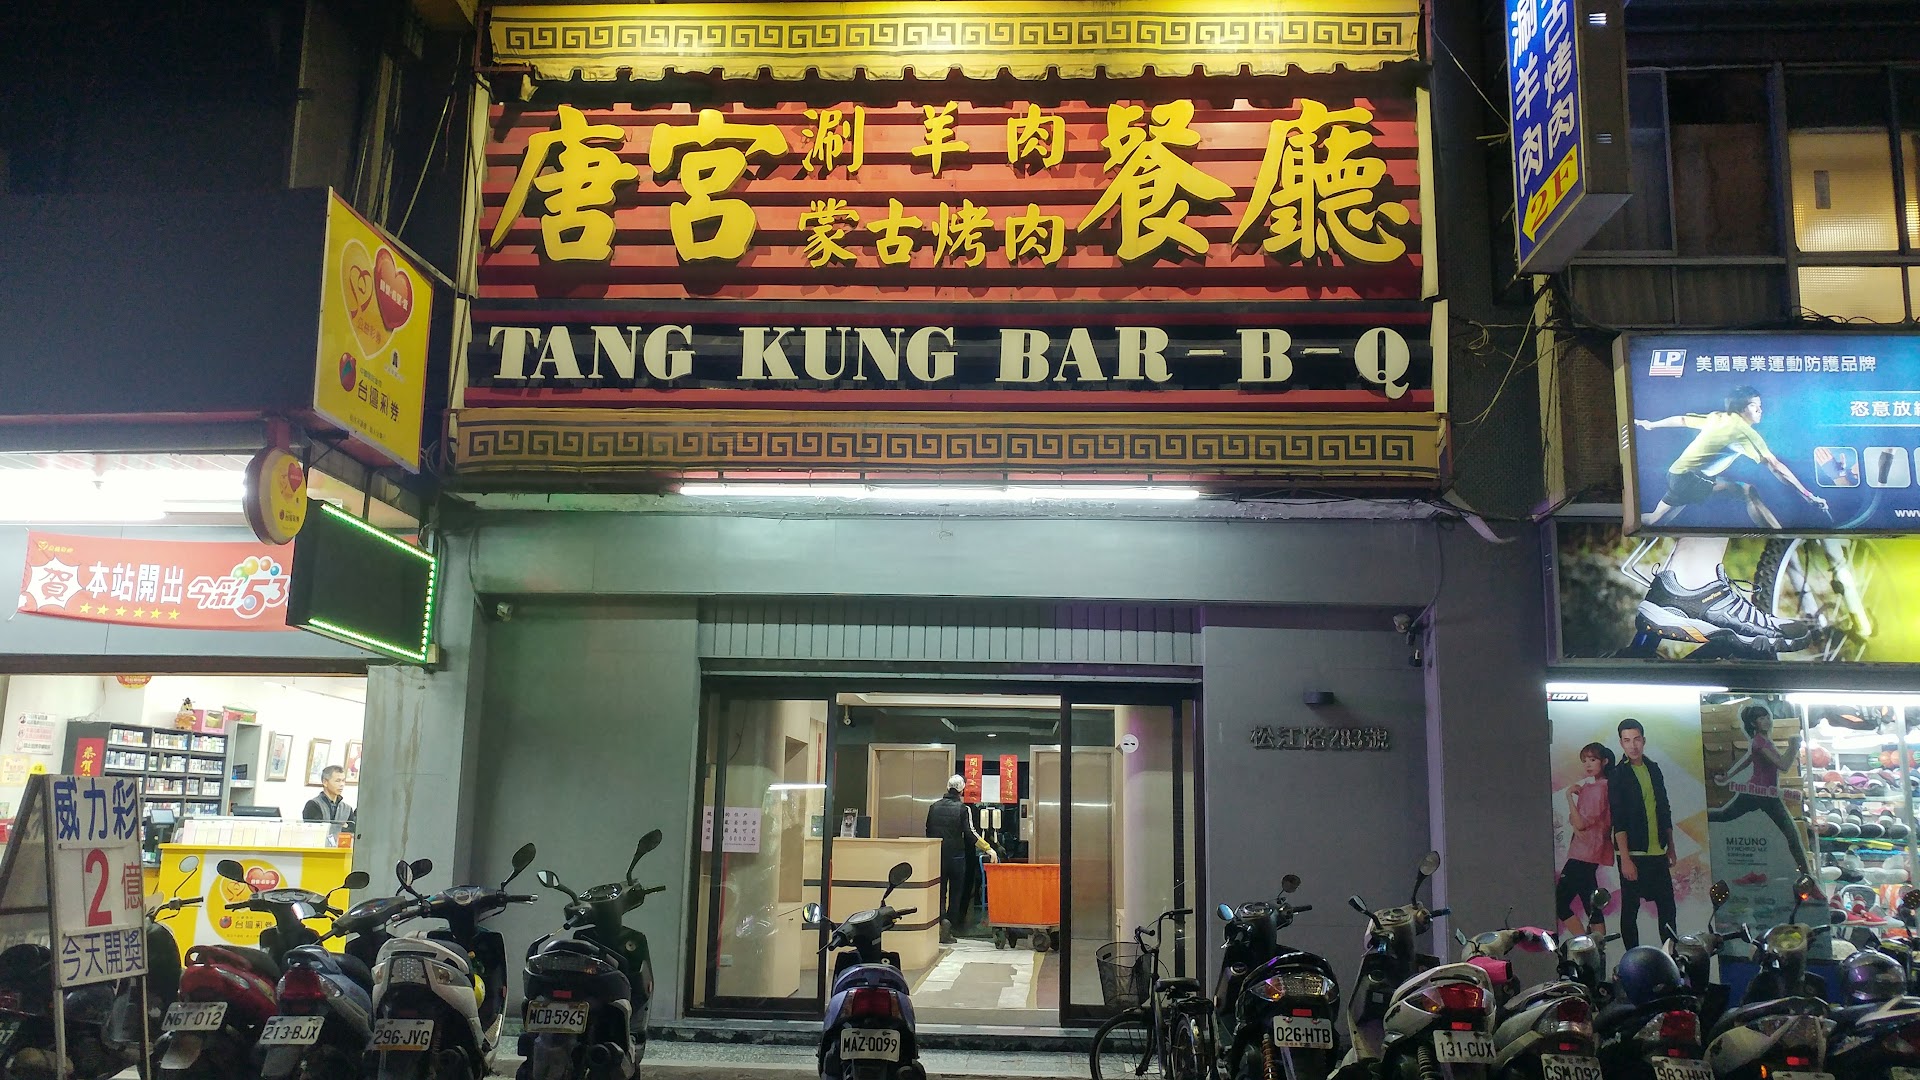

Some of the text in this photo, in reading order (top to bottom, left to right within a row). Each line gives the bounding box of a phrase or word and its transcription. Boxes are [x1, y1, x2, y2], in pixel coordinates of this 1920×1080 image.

[1541, 0, 1575, 160] 古烤肉
[489, 103, 789, 263] 唐宮
[1077, 98, 1411, 264] 餐廳
[1530, 154, 1574, 232] 2F
[797, 197, 1066, 269] 蒙古烤肉
[488, 324, 697, 382] TANG
[736, 325, 958, 382] KUNG
[1653, 351, 1681, 367] LP
[1695, 354, 1877, 374] 美國專業運動防護品牌
[38, 567, 74, 602] 賀
[86, 560, 184, 605] 本站開出
[187, 575, 291, 618] 今彩53
[79, 745, 97, 777] 恭賀
[53, 776, 138, 841] 威力彩
[1726, 837, 1768, 846] MIZUNO
[85, 848, 142, 926] 2 億
[263, 1025, 319, 1040] 213-BJX
[529, 1008, 585, 1026] MCB-5965
[374, 1029, 431, 1046] 296-JVG
[843, 1036, 898, 1054] MAZ-0099
[1276, 1026, 1331, 1044] 026-HTB
[1440, 1041, 1495, 1059] 131-CUX
